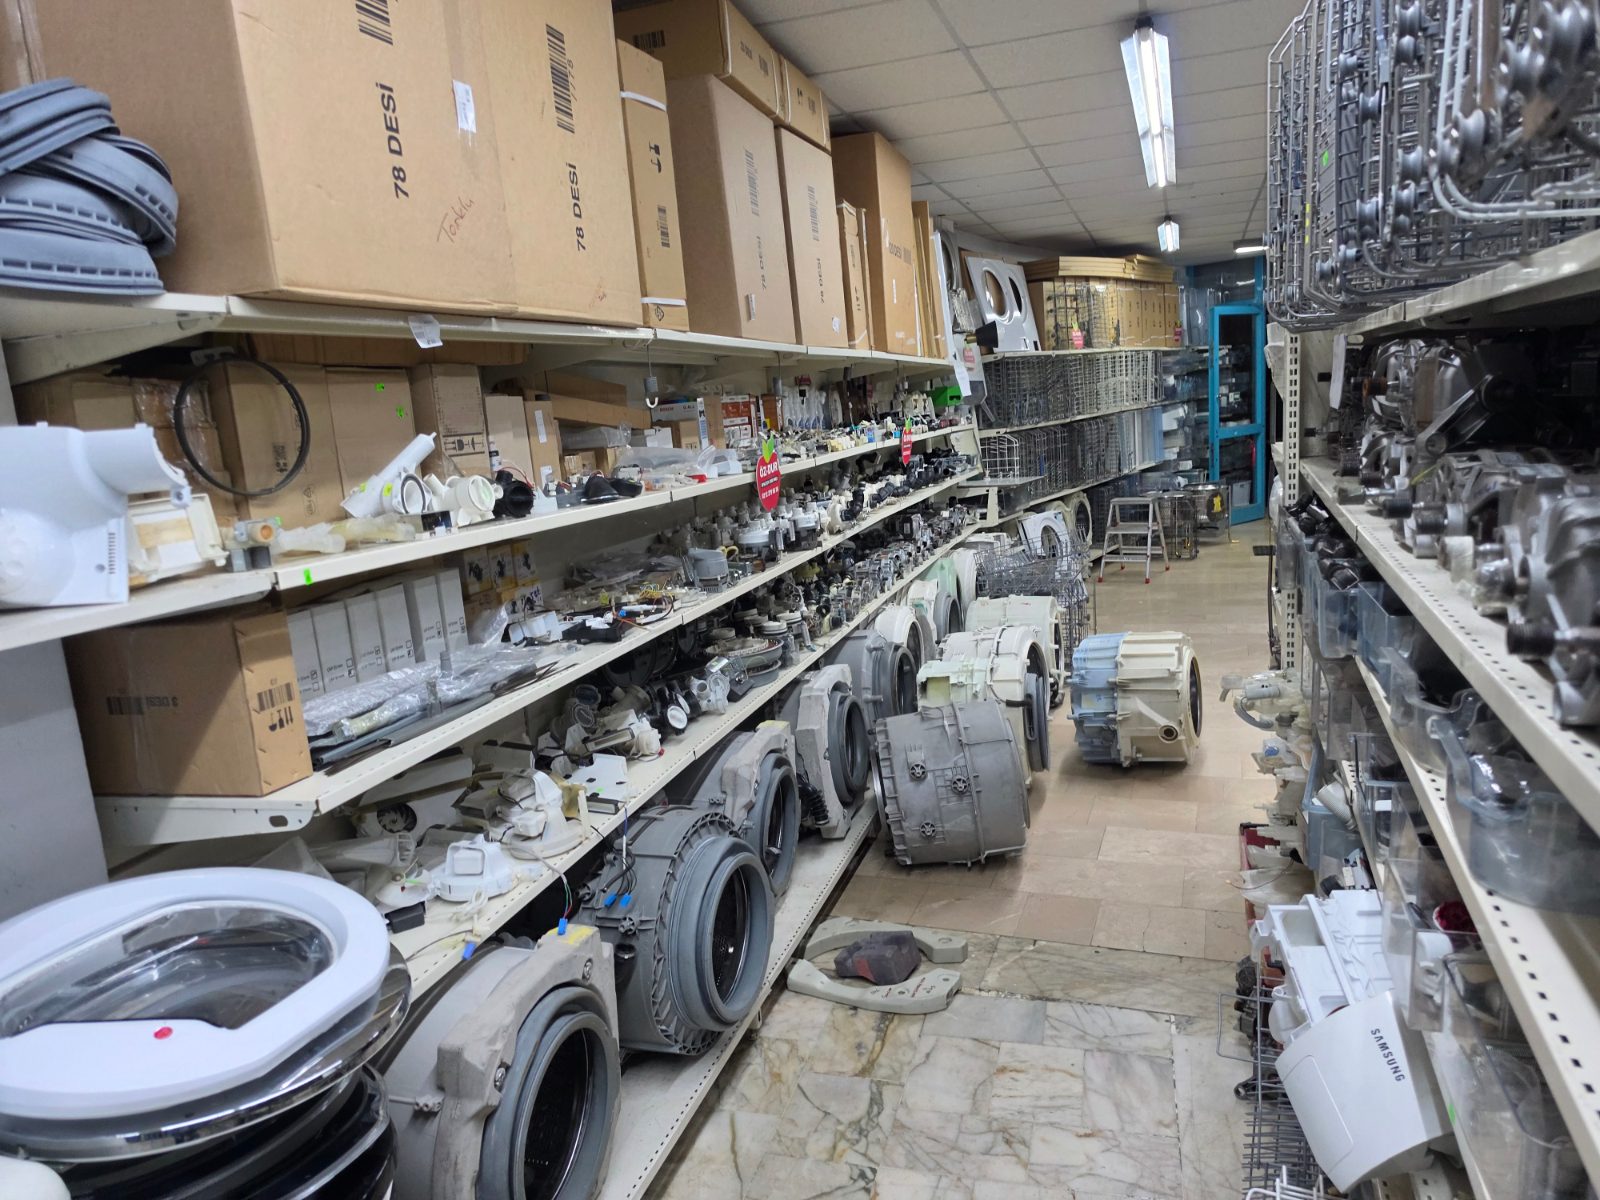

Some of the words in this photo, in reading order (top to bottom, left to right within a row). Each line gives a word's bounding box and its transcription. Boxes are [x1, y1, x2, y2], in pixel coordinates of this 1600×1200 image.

[391, 166, 409, 199] 78
[575, 226, 586, 251] 78
[1371, 1028, 1405, 1081] SAMSUNG
